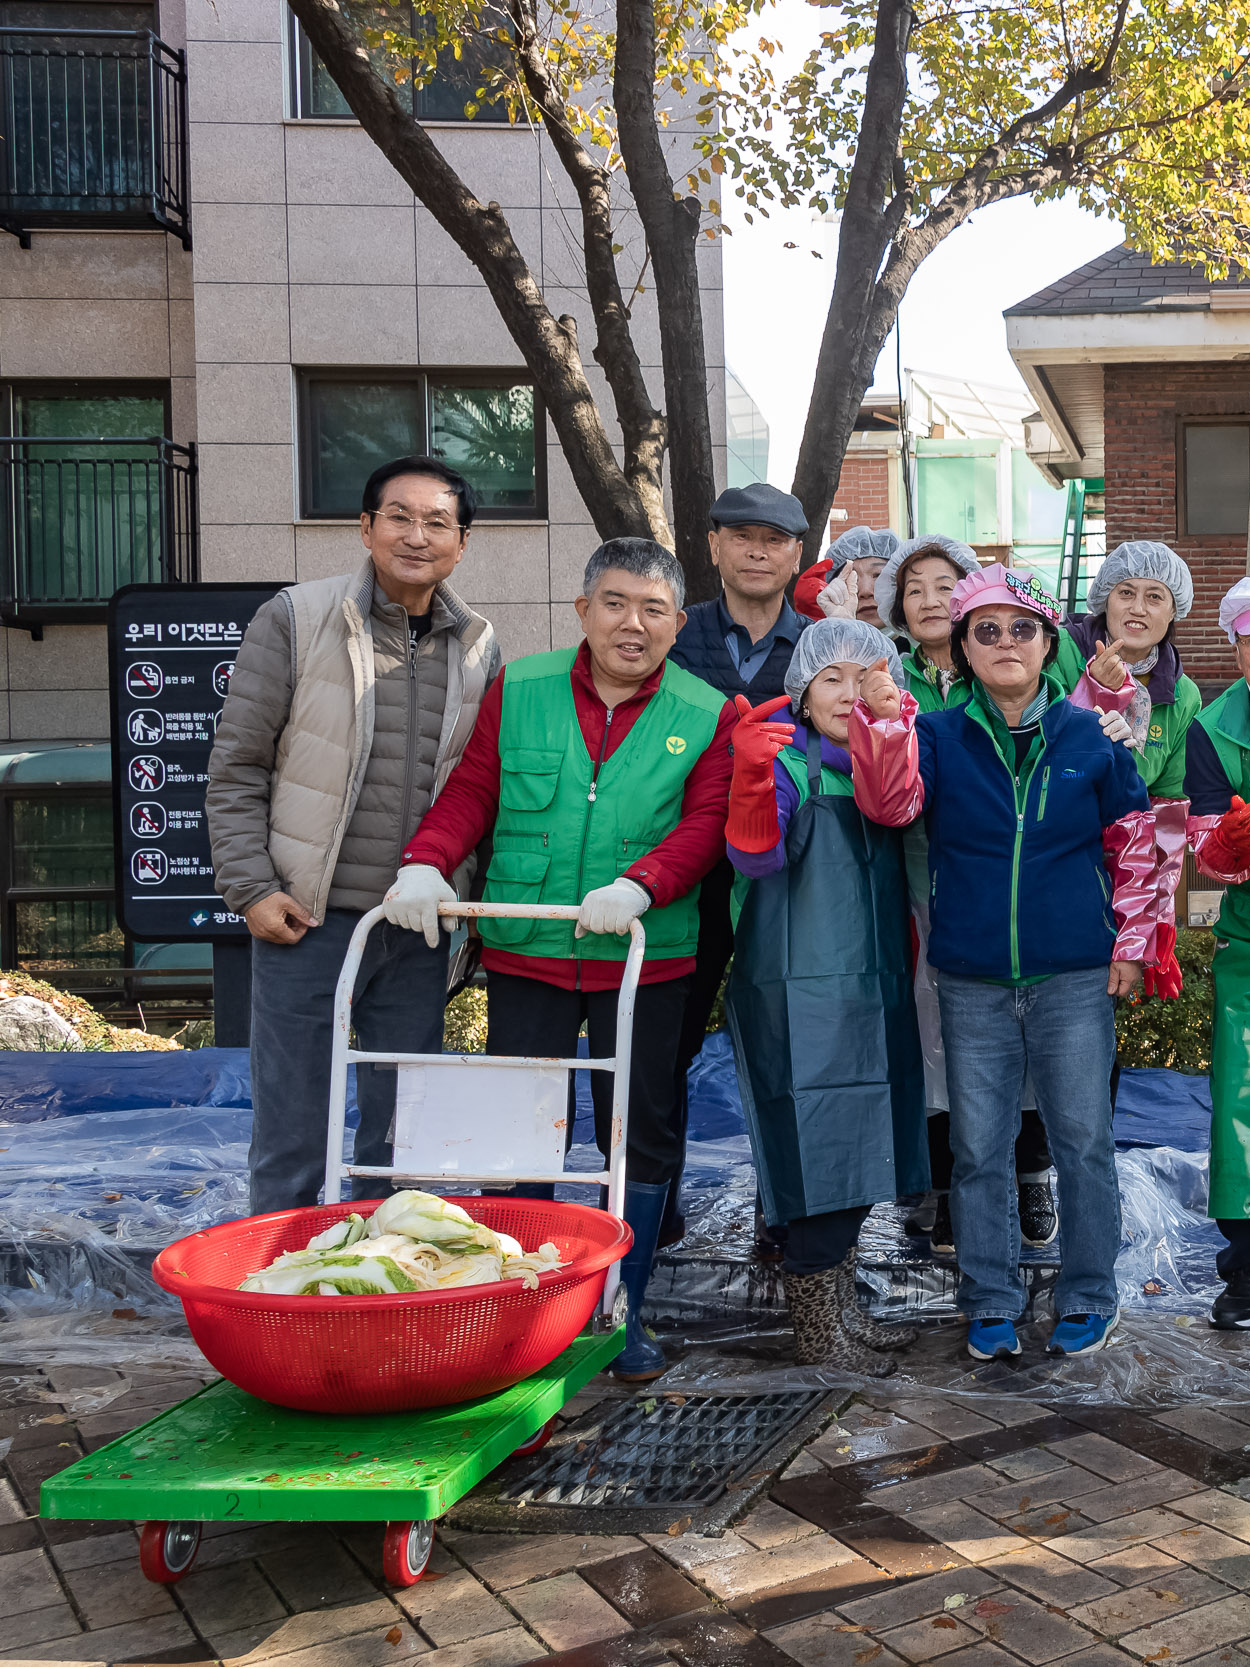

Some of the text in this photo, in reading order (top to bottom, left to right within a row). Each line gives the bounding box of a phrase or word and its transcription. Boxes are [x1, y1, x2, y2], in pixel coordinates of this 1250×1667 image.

[125, 622, 242, 642] 우리 이것만은
[165, 676, 195, 684] 흡연 금지
[165, 712, 214, 721] 반려동물 동반 시
[180, 722, 194, 731] 착용
[165, 732, 209, 741] 배변봉투 지참
[167, 774, 211, 782] 고성방가 금지
[168, 810, 202, 819] 전동킥보드
[168, 820, 198, 829] 이용 금지
[169, 857, 199, 866] 노점상 및
[169, 866, 213, 875] 취사행위 금지
[223, 1492, 244, 1517] 2
